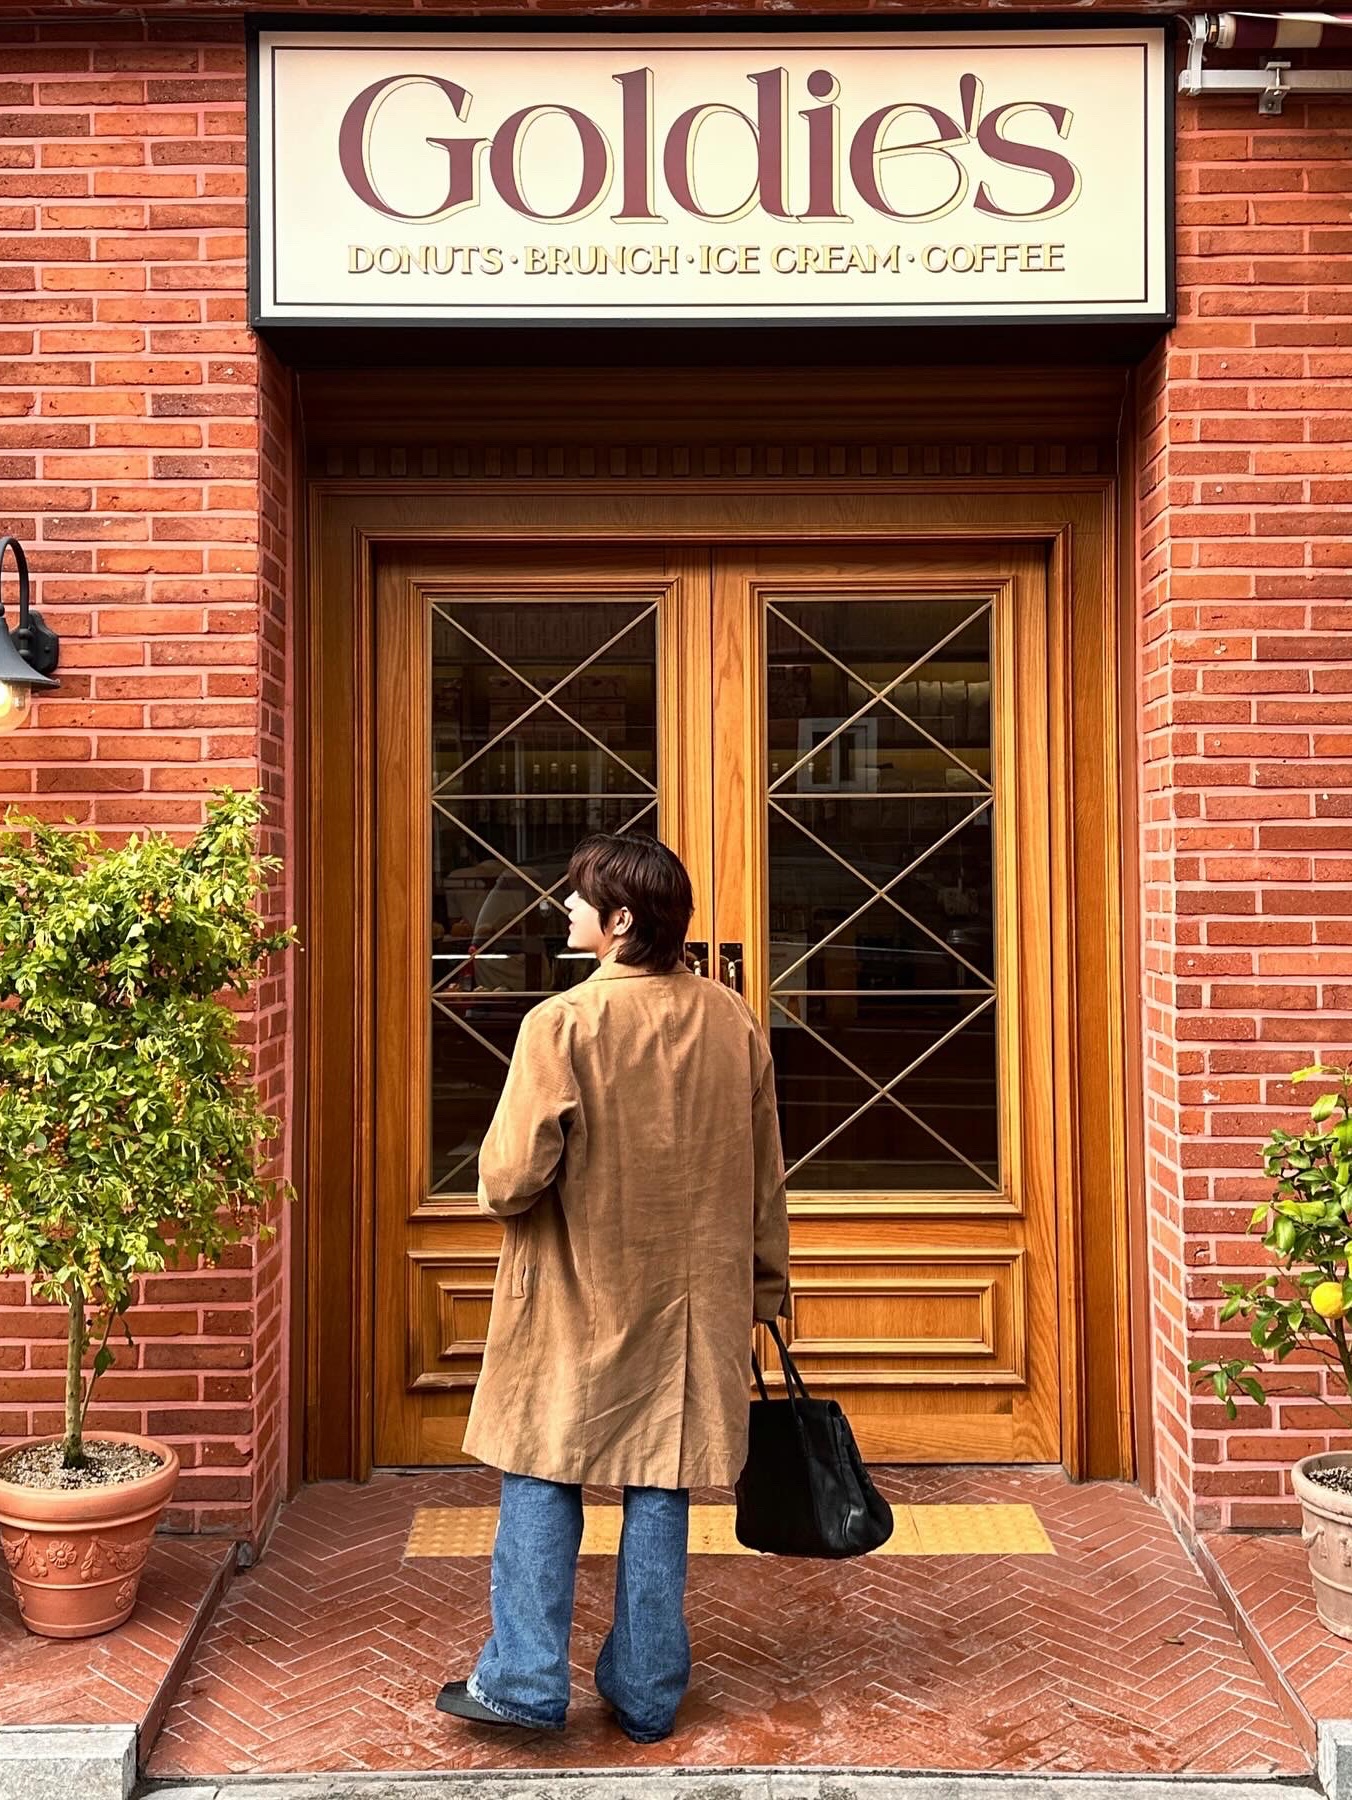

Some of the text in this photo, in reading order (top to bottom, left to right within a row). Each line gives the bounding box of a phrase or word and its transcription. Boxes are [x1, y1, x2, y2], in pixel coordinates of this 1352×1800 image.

[338, 66, 1082, 225] Goldie's
[347, 243, 1066, 275] DONUTS BRUNCH ICE CREAM COFFEE
